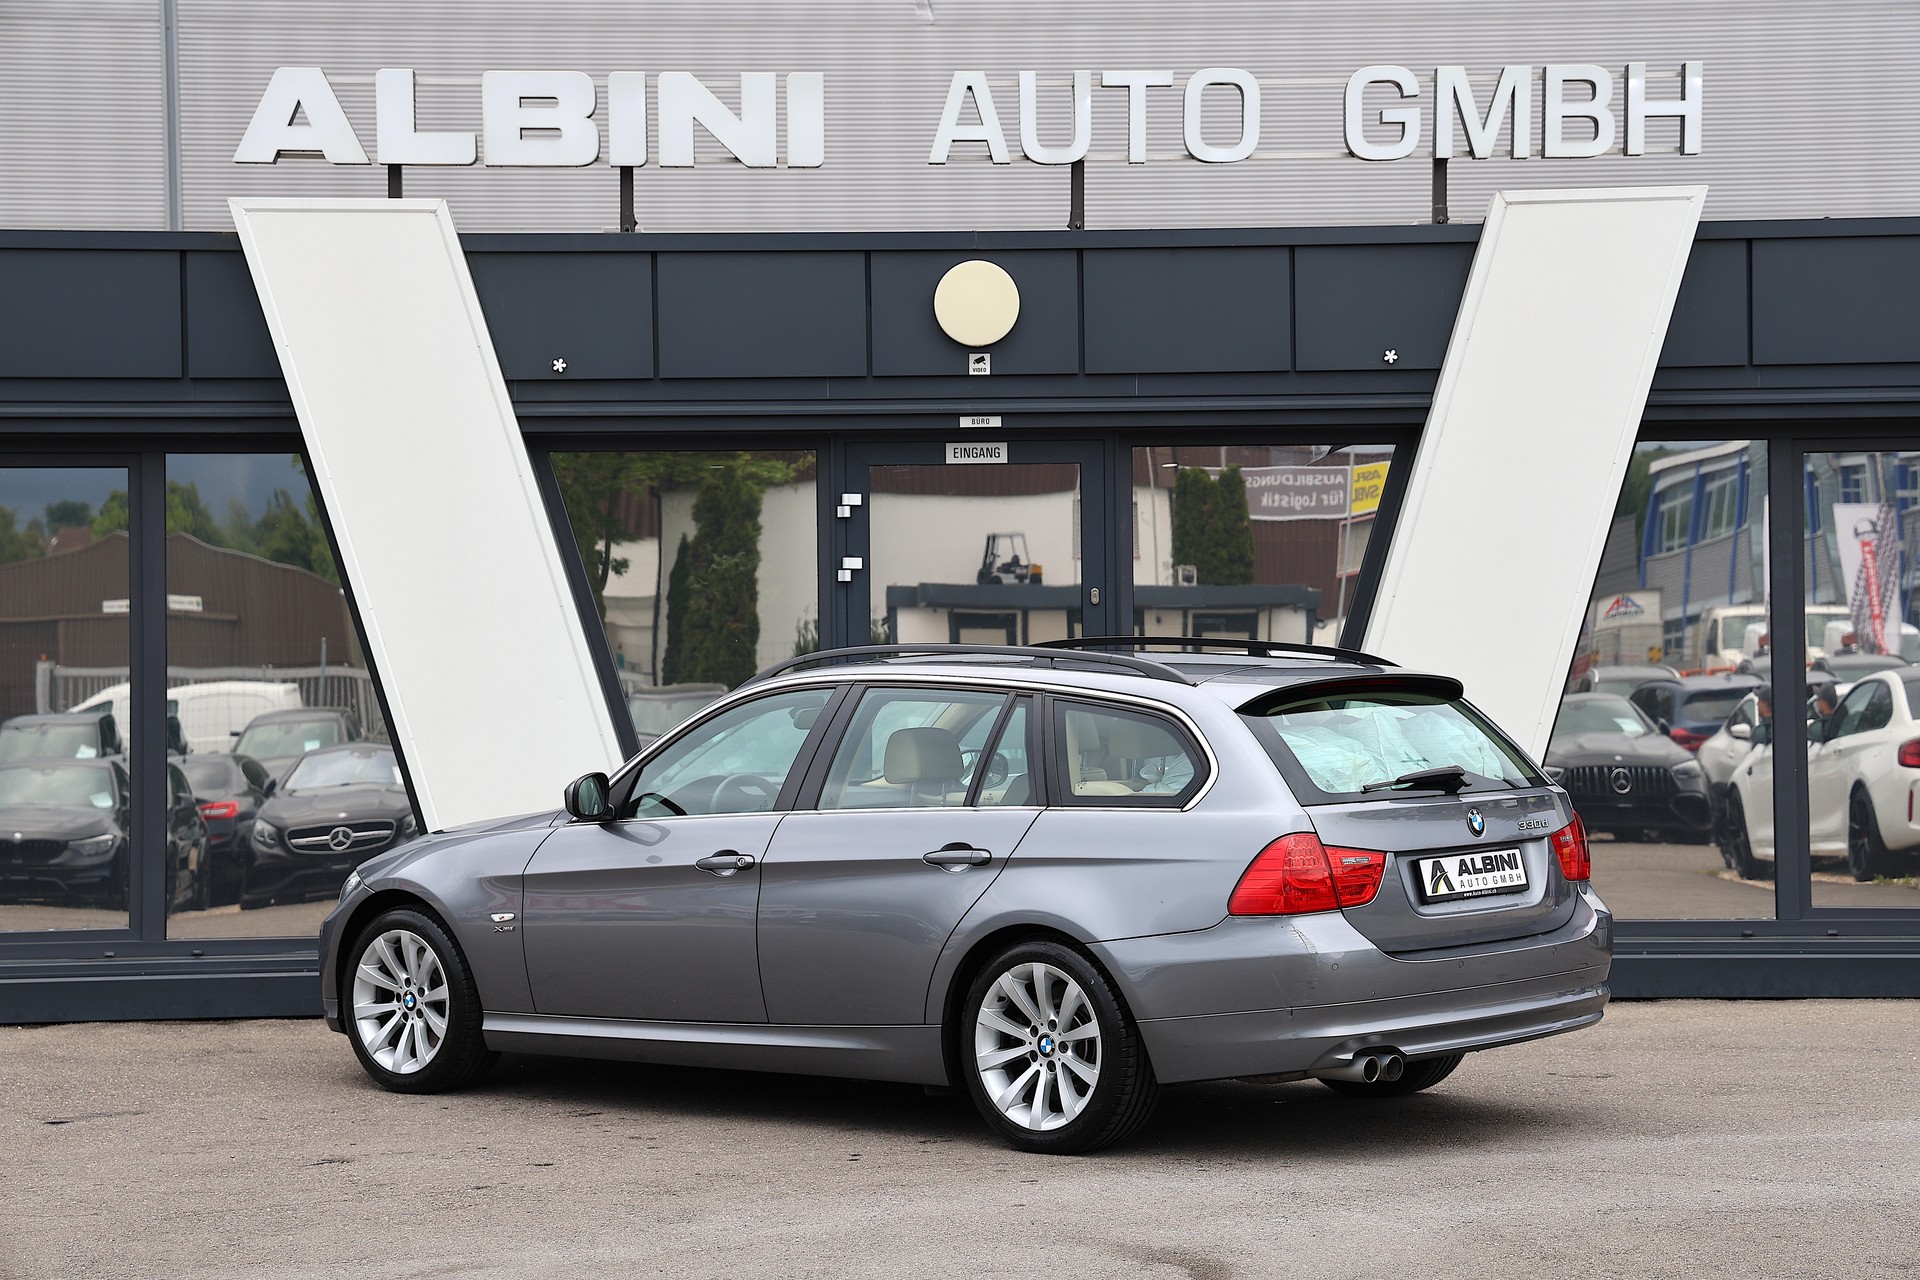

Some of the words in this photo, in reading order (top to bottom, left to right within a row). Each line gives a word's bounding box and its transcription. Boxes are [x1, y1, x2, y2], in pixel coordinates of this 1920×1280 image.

[232, 66, 825, 168] ALBINI
[928, 67, 1261, 165] AUTO
[1342, 60, 1704, 162] GMBH
[971, 416, 990, 425] BÜRO
[953, 447, 1001, 459] EINGANG
[1518, 818, 1549, 831] 330d
[1458, 852, 1519, 877] ALBINI
[1460, 875, 1489, 889] AUTO
[1492, 872, 1523, 885] GMBH
